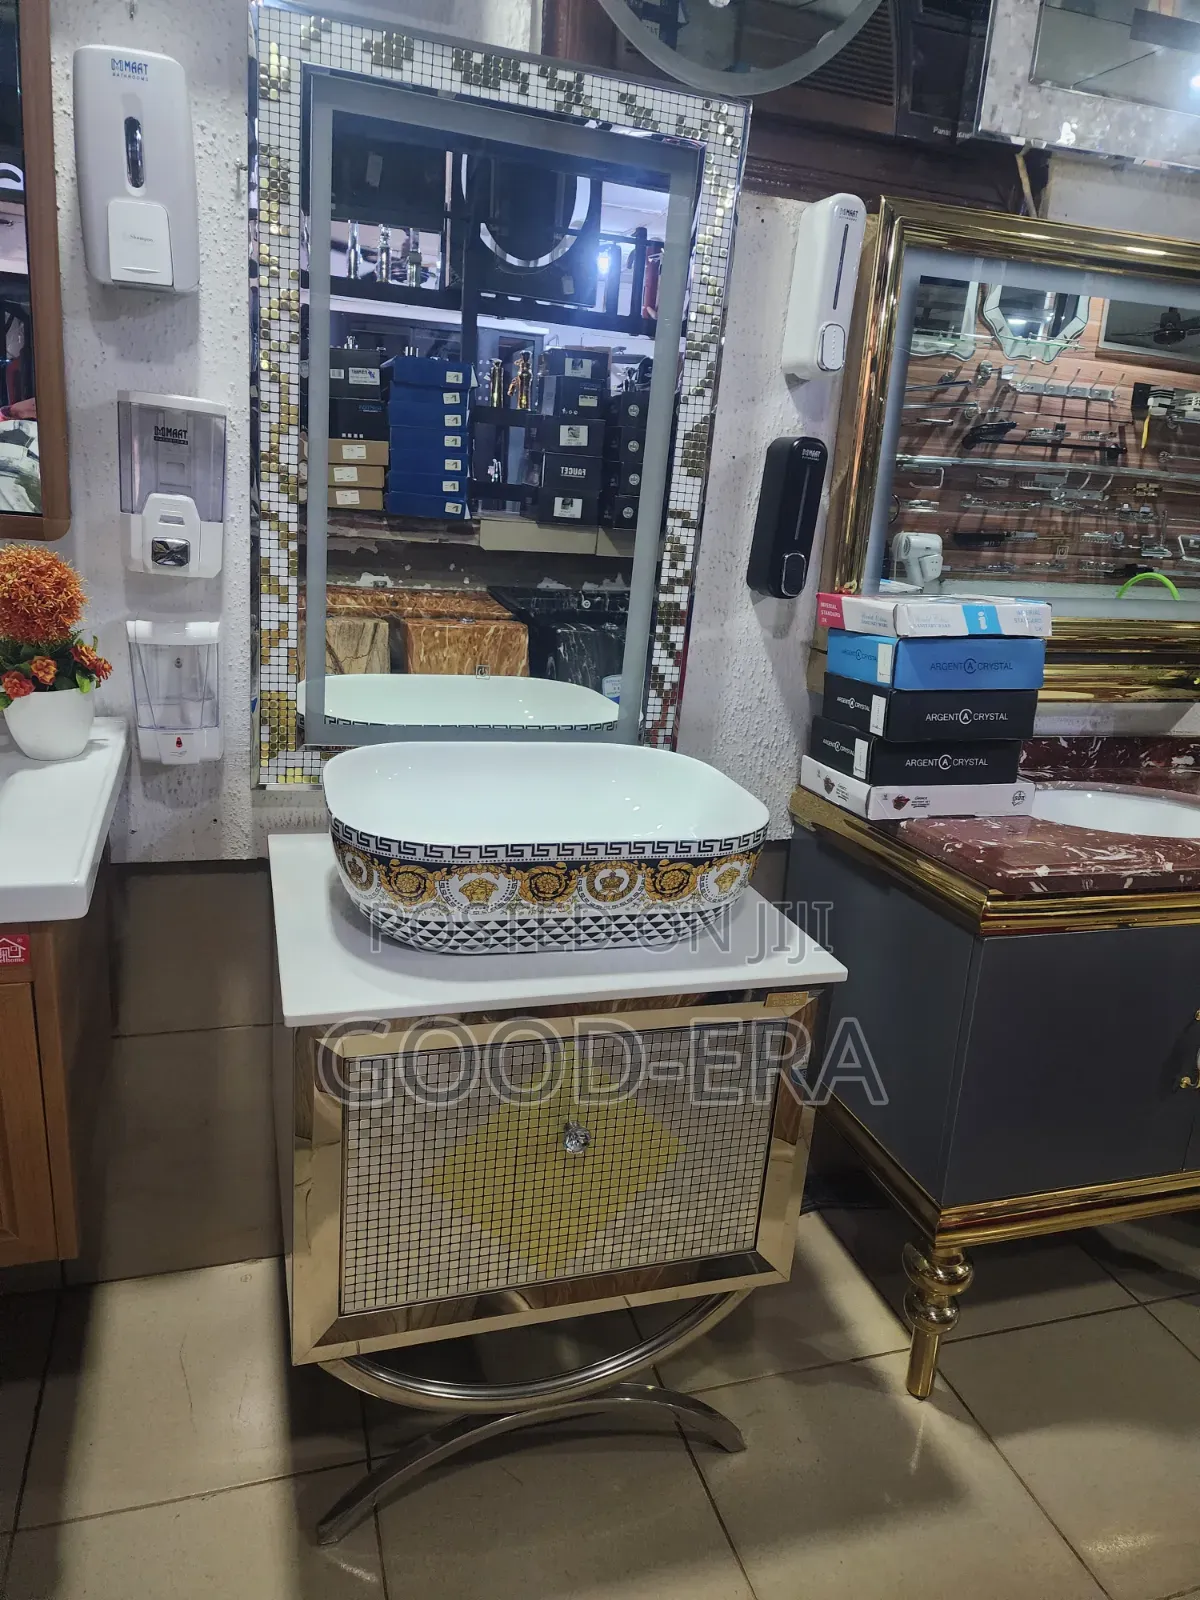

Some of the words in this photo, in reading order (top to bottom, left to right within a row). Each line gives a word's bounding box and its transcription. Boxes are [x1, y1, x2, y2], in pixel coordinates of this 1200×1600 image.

[861, 653, 877, 661] CRYSTA
[929, 662, 964, 671] ARGENT
[977, 662, 1013, 671] CRYSTAL
[925, 713, 960, 721] ARGENT
[972, 712, 1009, 721] CRYSTAL
[905, 759, 940, 767] ARGENT
[952, 758, 989, 766] CRYSTAL
